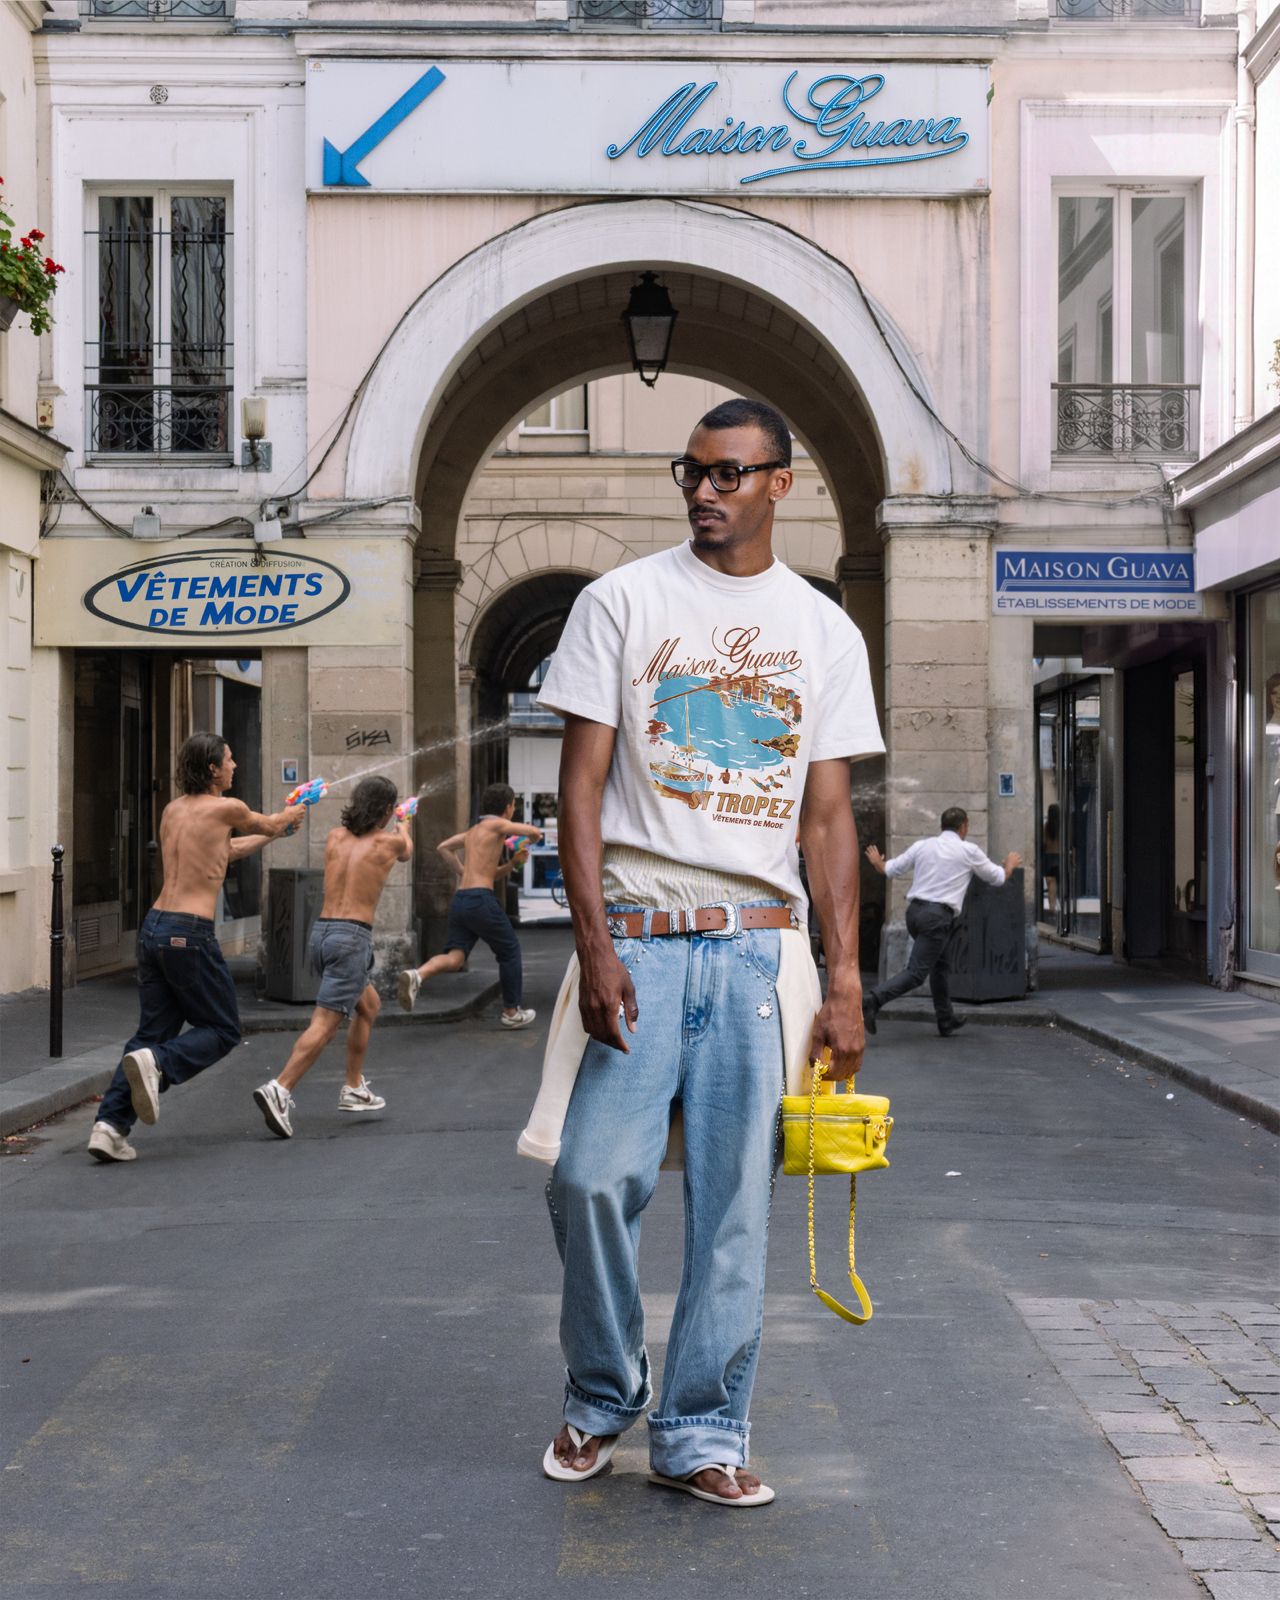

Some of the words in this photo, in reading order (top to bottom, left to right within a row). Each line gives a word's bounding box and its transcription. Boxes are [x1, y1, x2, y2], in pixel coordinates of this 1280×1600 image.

[607, 81, 792, 159] Maison
[783, 70, 970, 160] Guava
[209, 559, 248, 568] CRÉATION
[260, 560, 303, 568] DIFFUSION
[1004, 557, 1100, 578] MAISON
[1107, 556, 1189, 579] GUAVA
[117, 570, 324, 602] VÊTEMENTS
[149, 607, 188, 627] DE
[200, 601, 299, 626] MODE
[997, 595, 1127, 609] ÉTABLISSEMENTS
[1130, 598, 1150, 609] DE
[1153, 599, 1197, 610] MODE
[632, 637, 718, 687] Maison
[712, 626, 803, 676] Guava
[688, 790, 714, 811] ST
[716, 791, 796, 820] TROPEZ
[712, 813, 752, 826] VÊTEMENTS
[753, 819, 763, 827] DE
[763, 819, 784, 830] MODE
